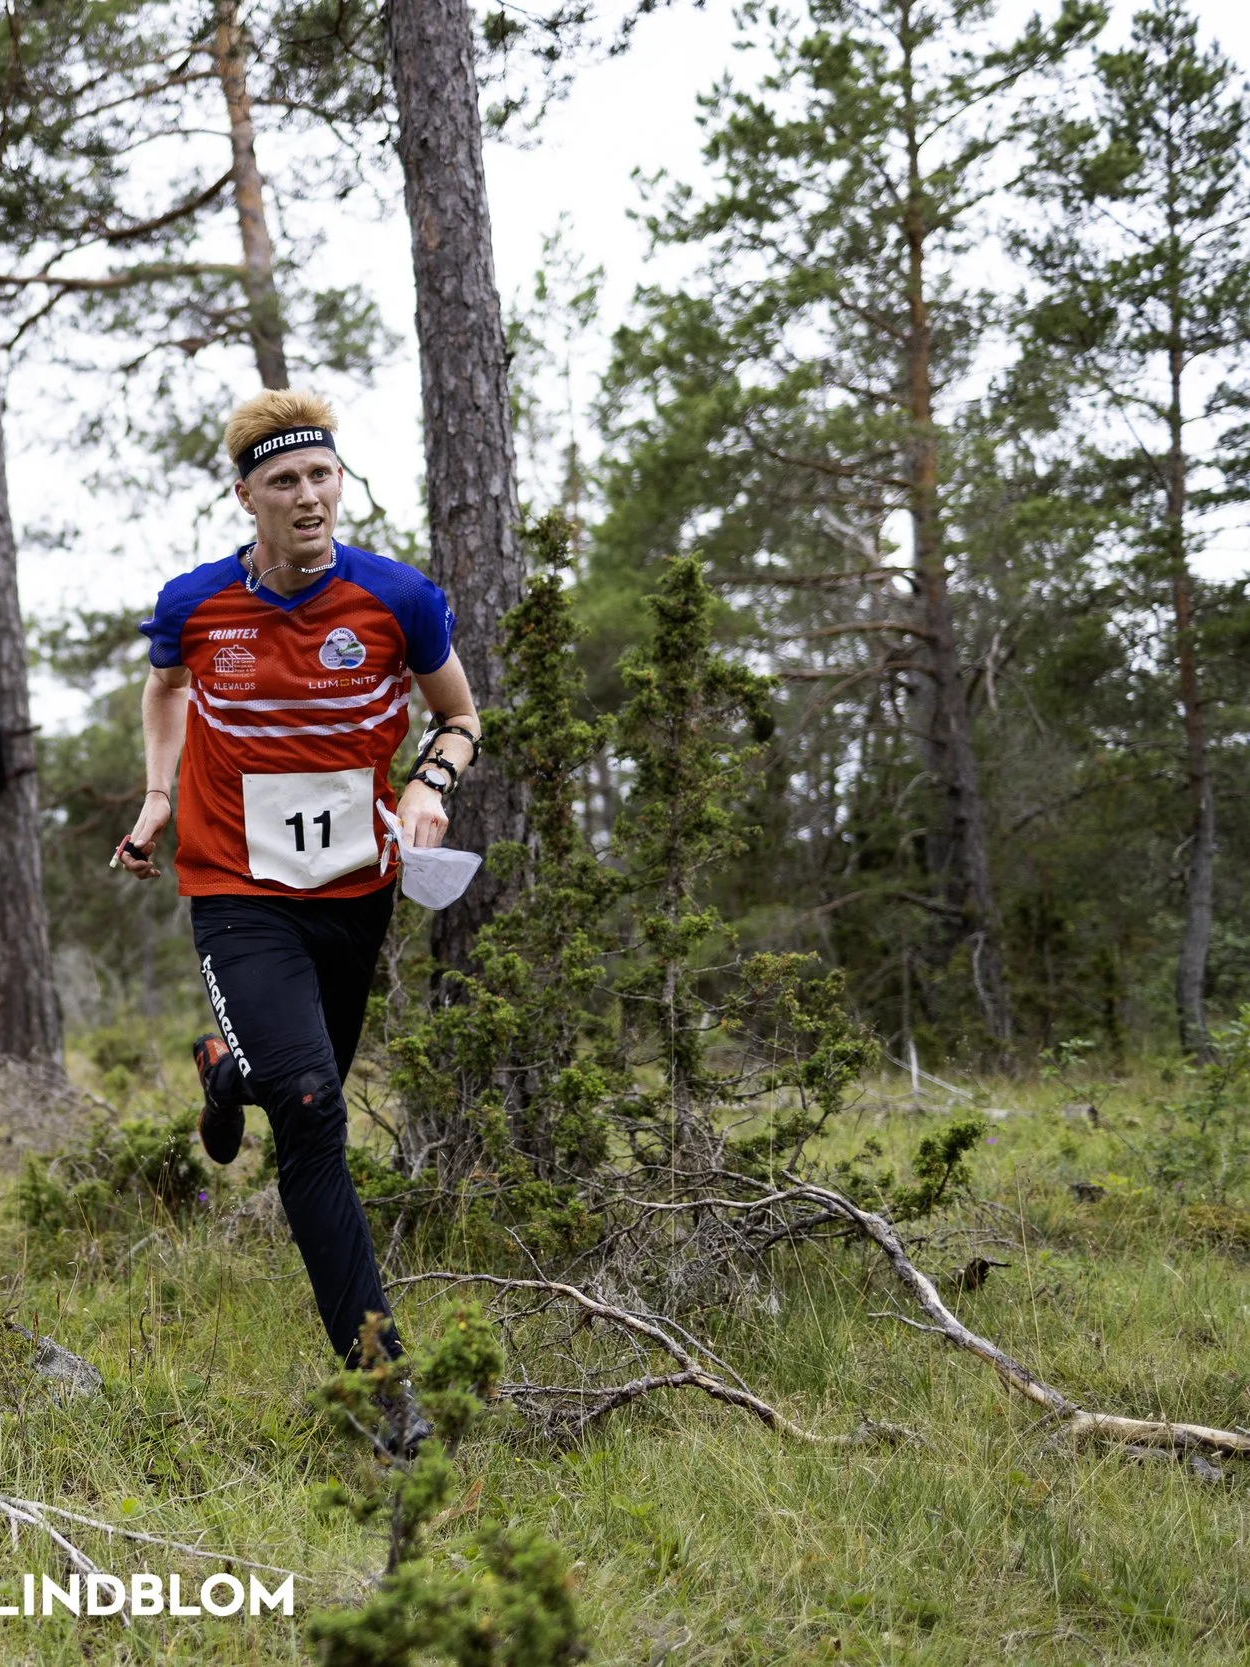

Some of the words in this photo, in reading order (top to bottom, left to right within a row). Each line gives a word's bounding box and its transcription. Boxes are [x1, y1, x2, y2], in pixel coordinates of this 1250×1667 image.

[253, 430, 323, 460] noname
[208, 628, 258, 640] TRIMTEX
[213, 682, 256, 690] ALEWALDS
[308, 675, 377, 690] LUMONITE
[285, 810, 330, 852] 11
